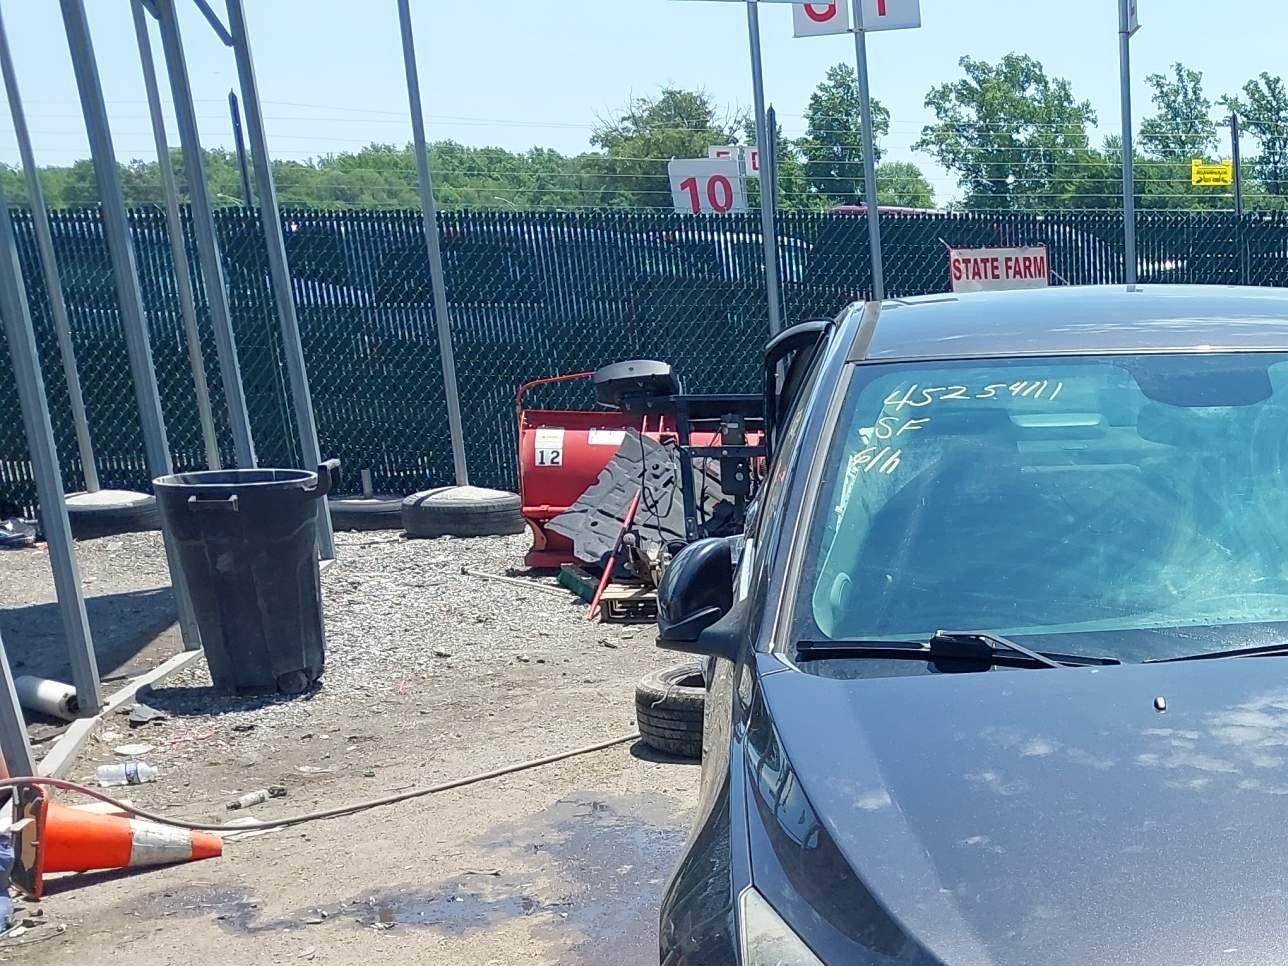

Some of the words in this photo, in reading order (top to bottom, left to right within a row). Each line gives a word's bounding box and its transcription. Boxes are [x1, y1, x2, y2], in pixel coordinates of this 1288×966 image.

[680, 174, 733, 215] 10
[953, 257, 1000, 280] STATE
[1004, 256, 1046, 279] FARM
[875, 417, 932, 439] SF
[538, 449, 560, 465] 12
